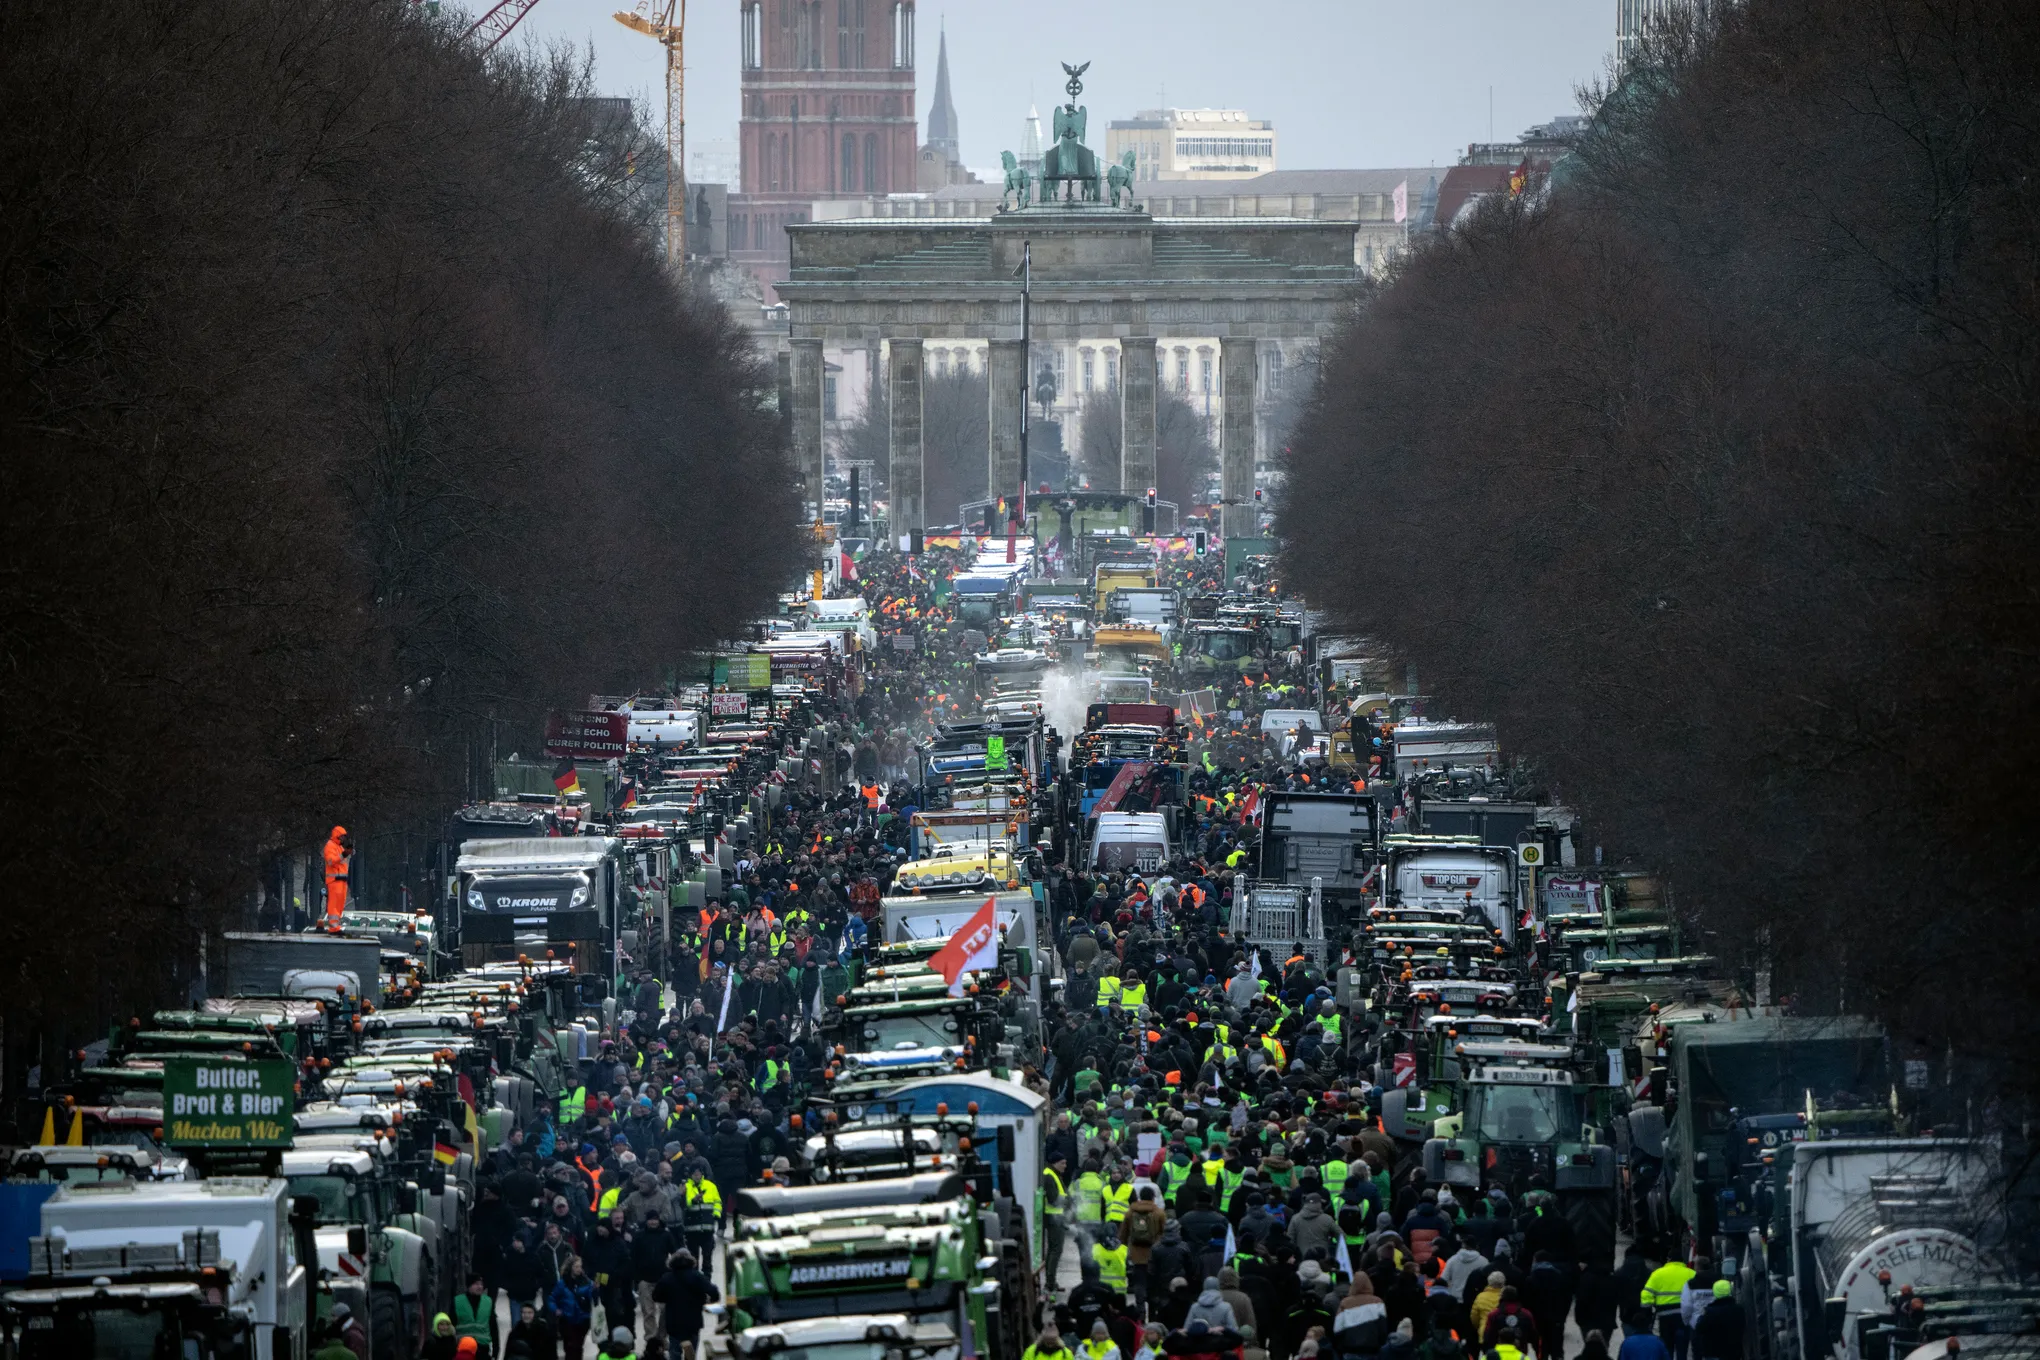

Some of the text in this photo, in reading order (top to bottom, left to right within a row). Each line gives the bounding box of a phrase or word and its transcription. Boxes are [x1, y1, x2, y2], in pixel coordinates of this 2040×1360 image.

[584, 728, 610, 737] ECHO
[547, 738, 623, 751] EURER POLITIK
[1435, 874, 1468, 885] TOP GUN
[511, 898, 558, 907] KRONE
[173, 1093, 284, 1115] Brot & Bier
[172, 1120, 285, 1140] Machen Wir
[1868, 1244, 1918, 1279] FREIE
[789, 1260, 912, 1284] AGRARSERVICE-MV
